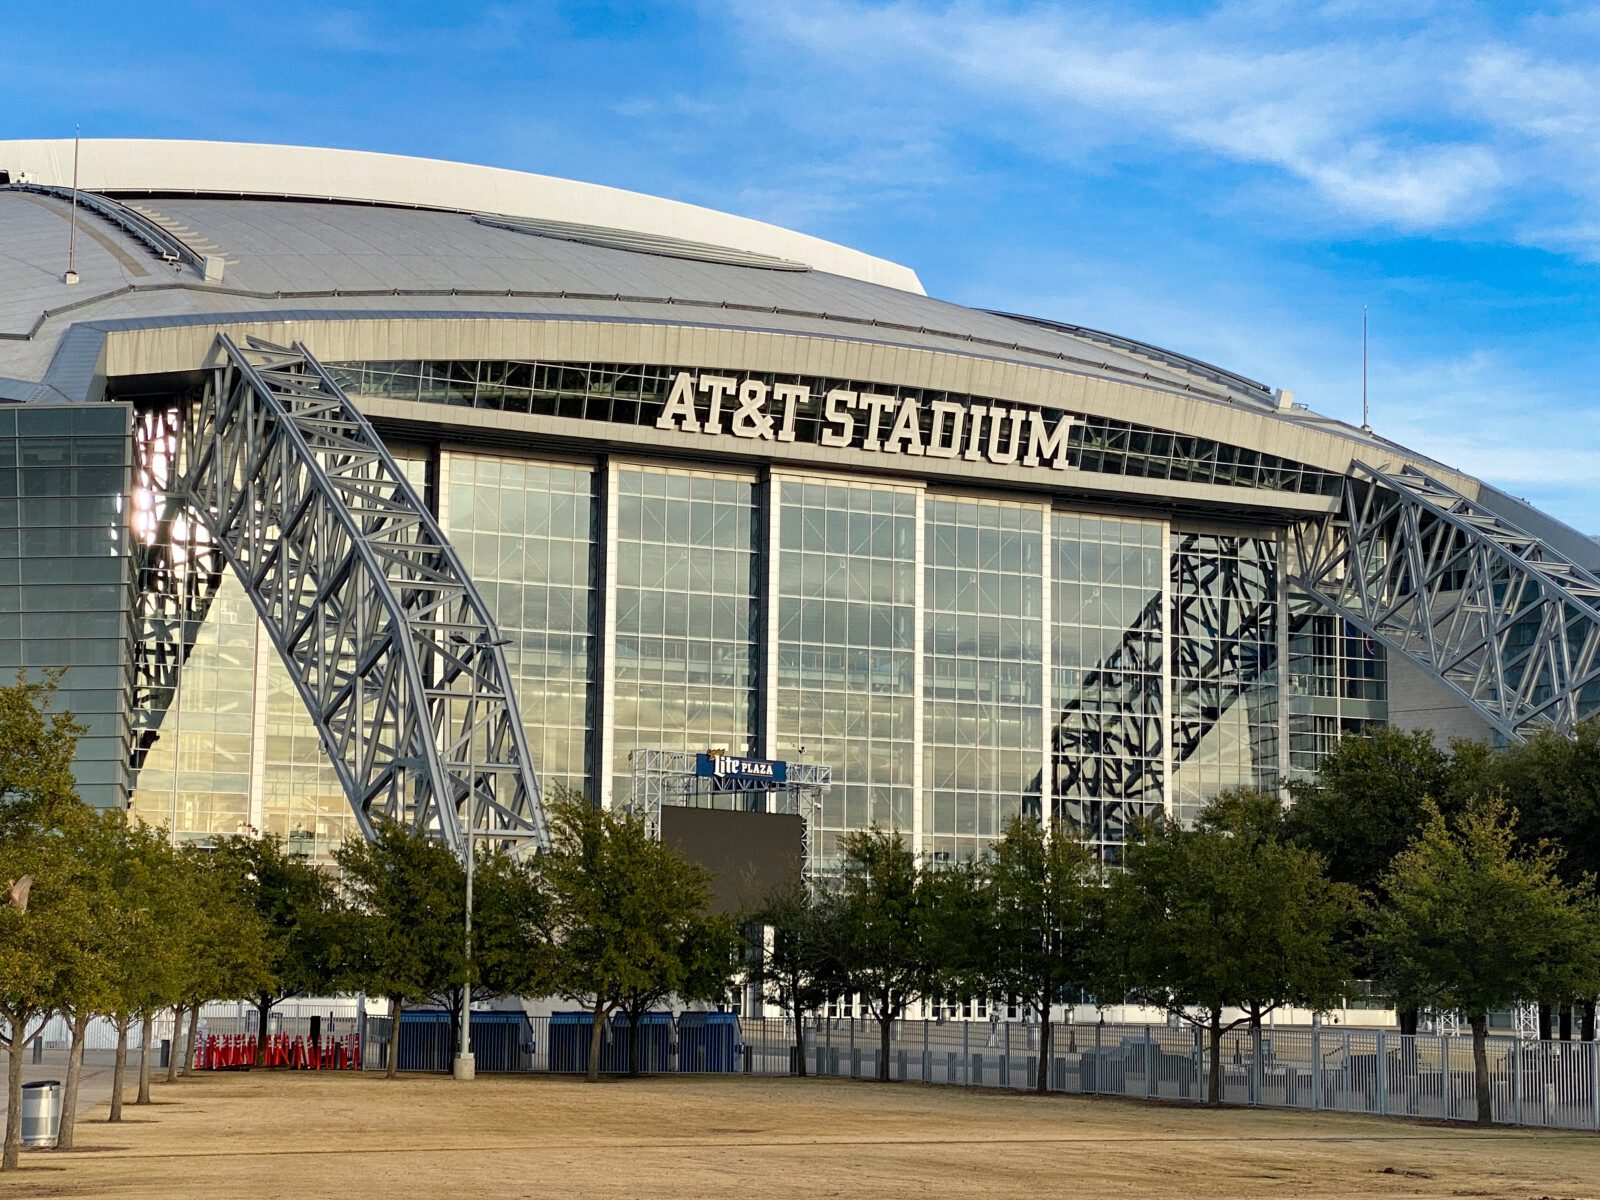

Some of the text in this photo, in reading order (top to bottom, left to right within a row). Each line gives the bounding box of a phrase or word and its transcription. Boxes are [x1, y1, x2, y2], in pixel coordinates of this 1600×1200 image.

[656, 372, 1075, 470] AT&T STADIUM
[714, 755, 773, 777] Lite PLAZA
